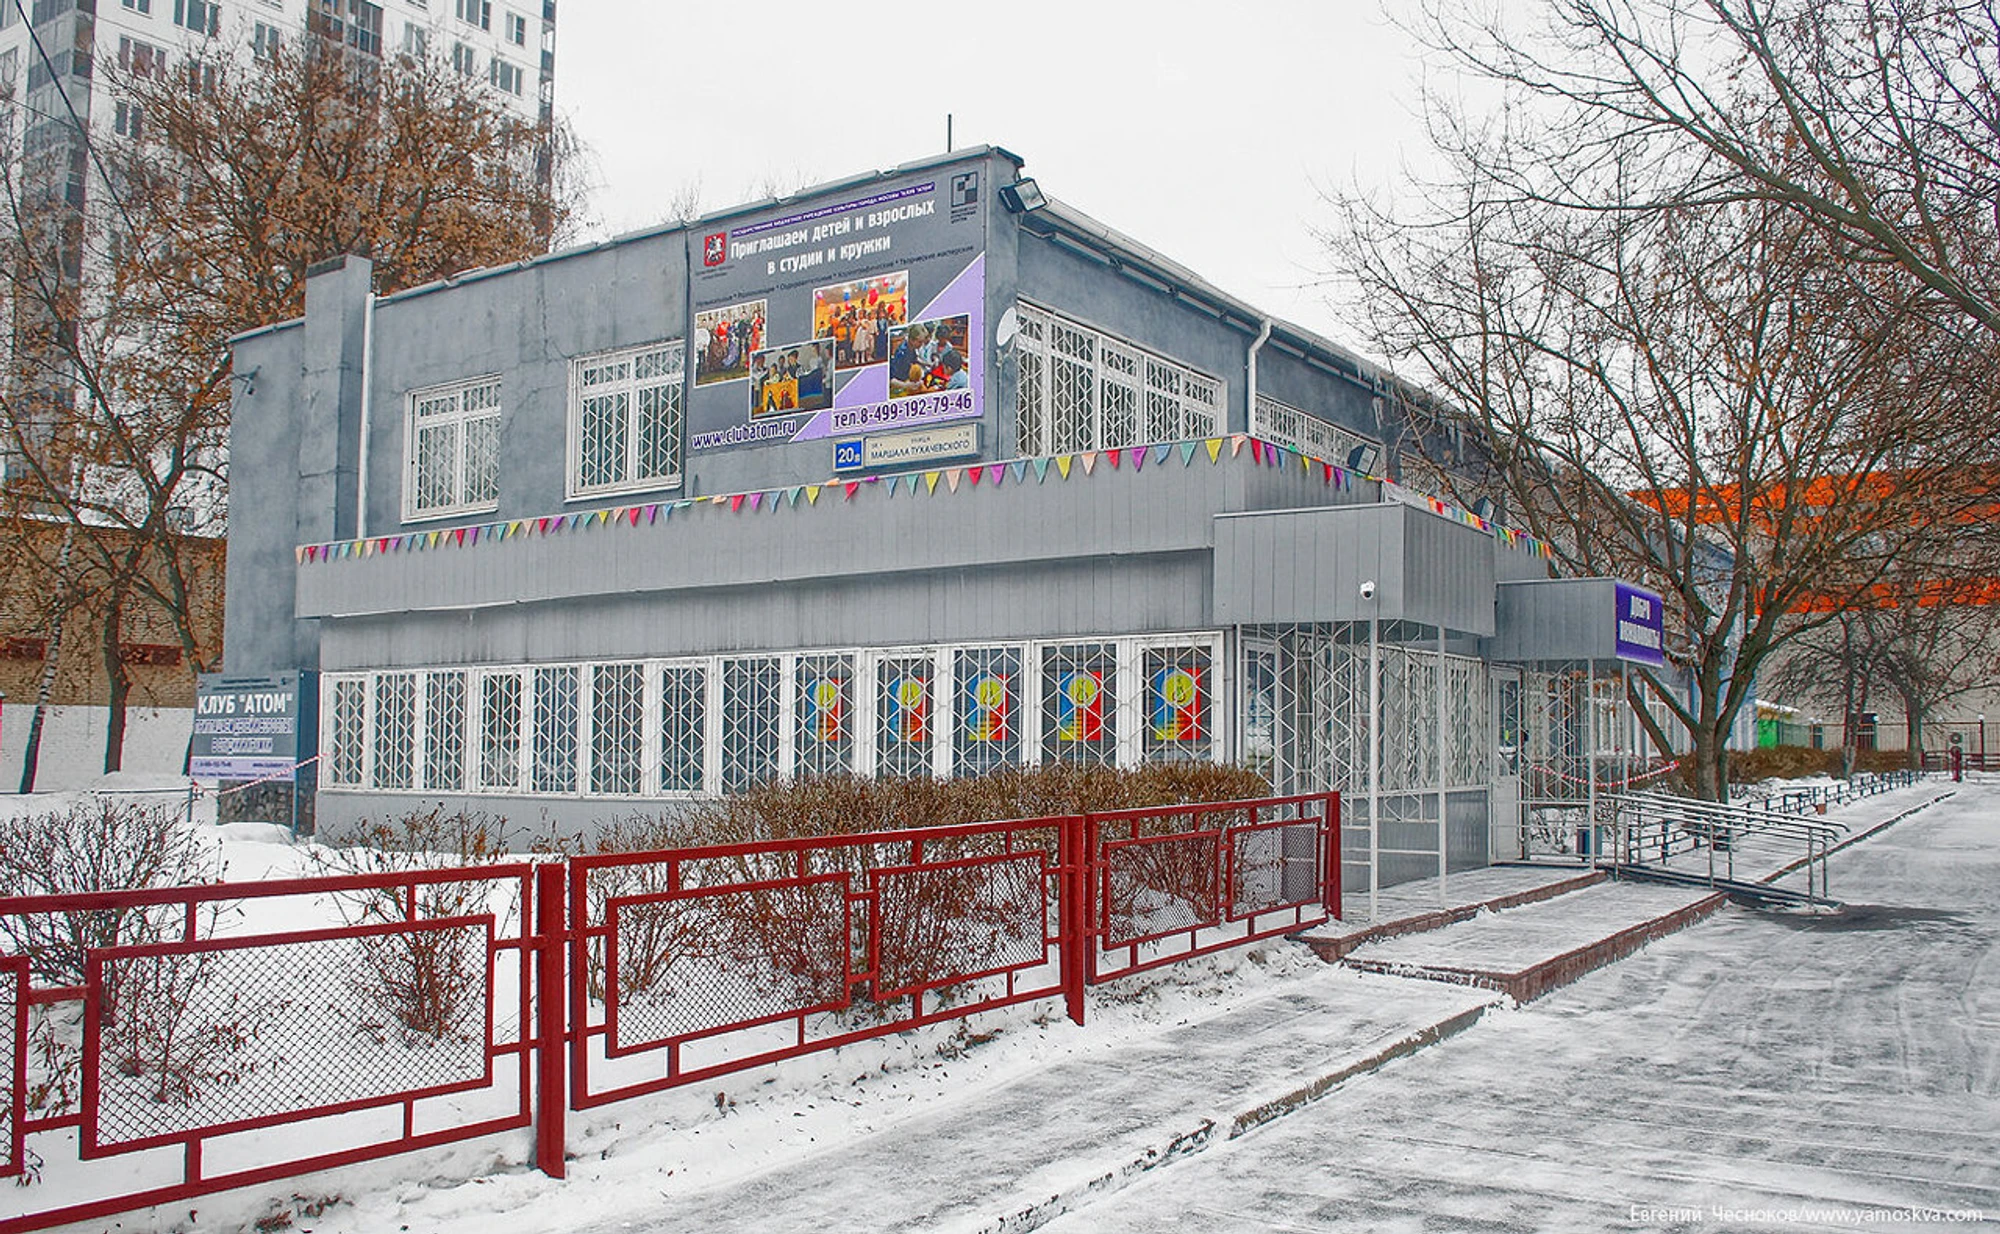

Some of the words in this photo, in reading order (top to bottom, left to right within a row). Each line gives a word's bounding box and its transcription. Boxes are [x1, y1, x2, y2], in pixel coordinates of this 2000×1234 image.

[731, 229, 808, 259] Приглашаем
[812, 216, 851, 243] детей
[855, 216, 864, 230] и
[868, 199, 936, 228] взрослых
[767, 260, 775, 275] в
[779, 250, 823, 272] студии
[827, 248, 836, 262] и
[840, 235, 891, 260] кружки
[834, 392, 973, 425] тел.8-499-192-79-46
[692, 421, 796, 449] www.clubatom.ru
[871, 447, 910, 459] МАРШАЛА
[910, 439, 970, 455] ТУХАЧЕВСКОГО
[197, 694, 236, 714] КЛУБ
[239, 692, 293, 714] "АТОМ"
